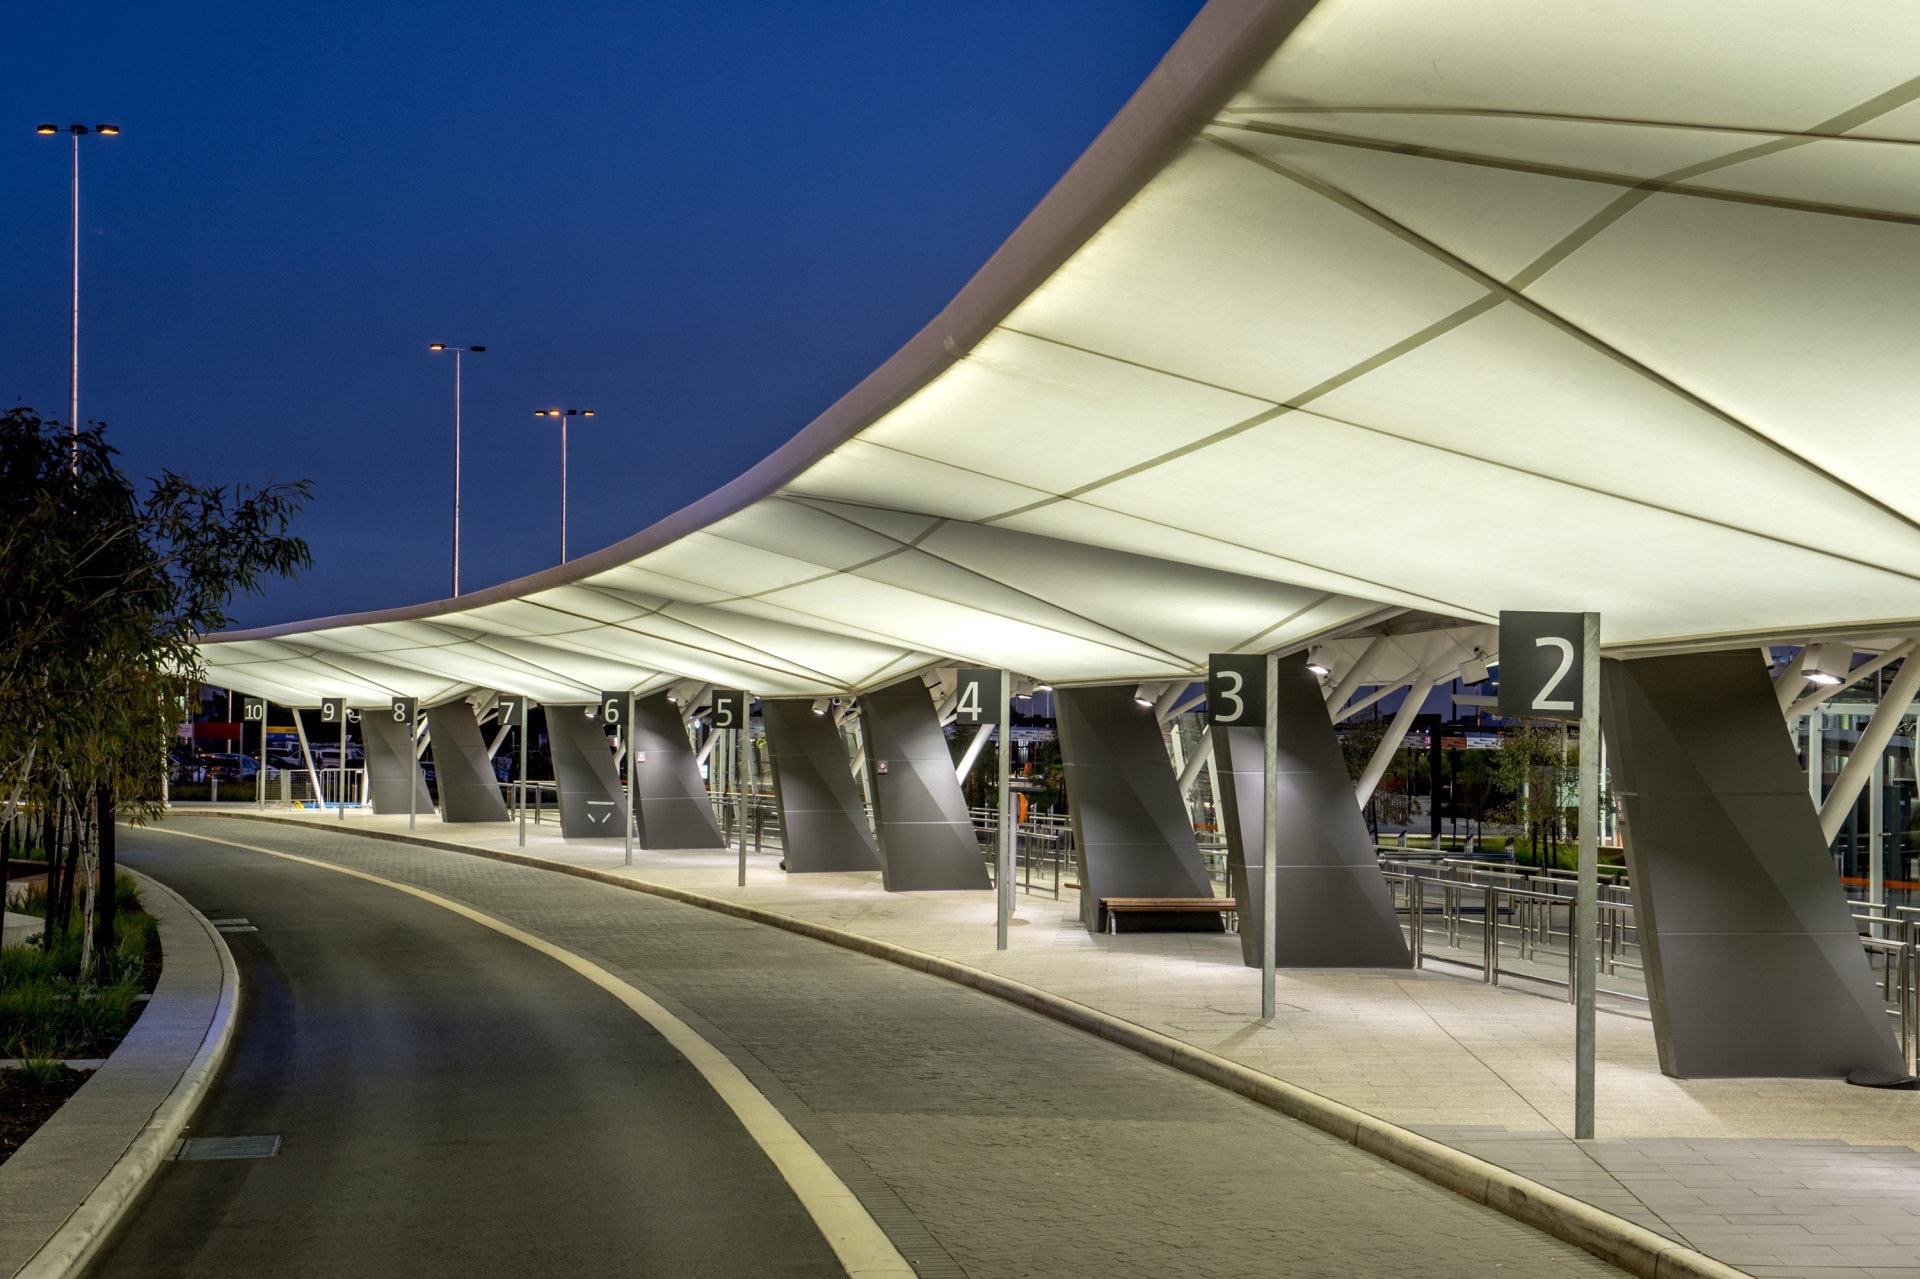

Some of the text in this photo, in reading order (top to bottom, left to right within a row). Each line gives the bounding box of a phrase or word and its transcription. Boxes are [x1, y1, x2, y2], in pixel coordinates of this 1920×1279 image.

[1532, 636, 1574, 710] 2
[957, 681, 982, 721] 4
[1215, 671, 1243, 721] 3
[245, 704, 262, 720] 10
[324, 703, 335, 722] 9
[394, 703, 406, 722] 8
[501, 702, 515, 724] 7
[605, 699, 619, 723] 6
[716, 699, 732, 726] 5
